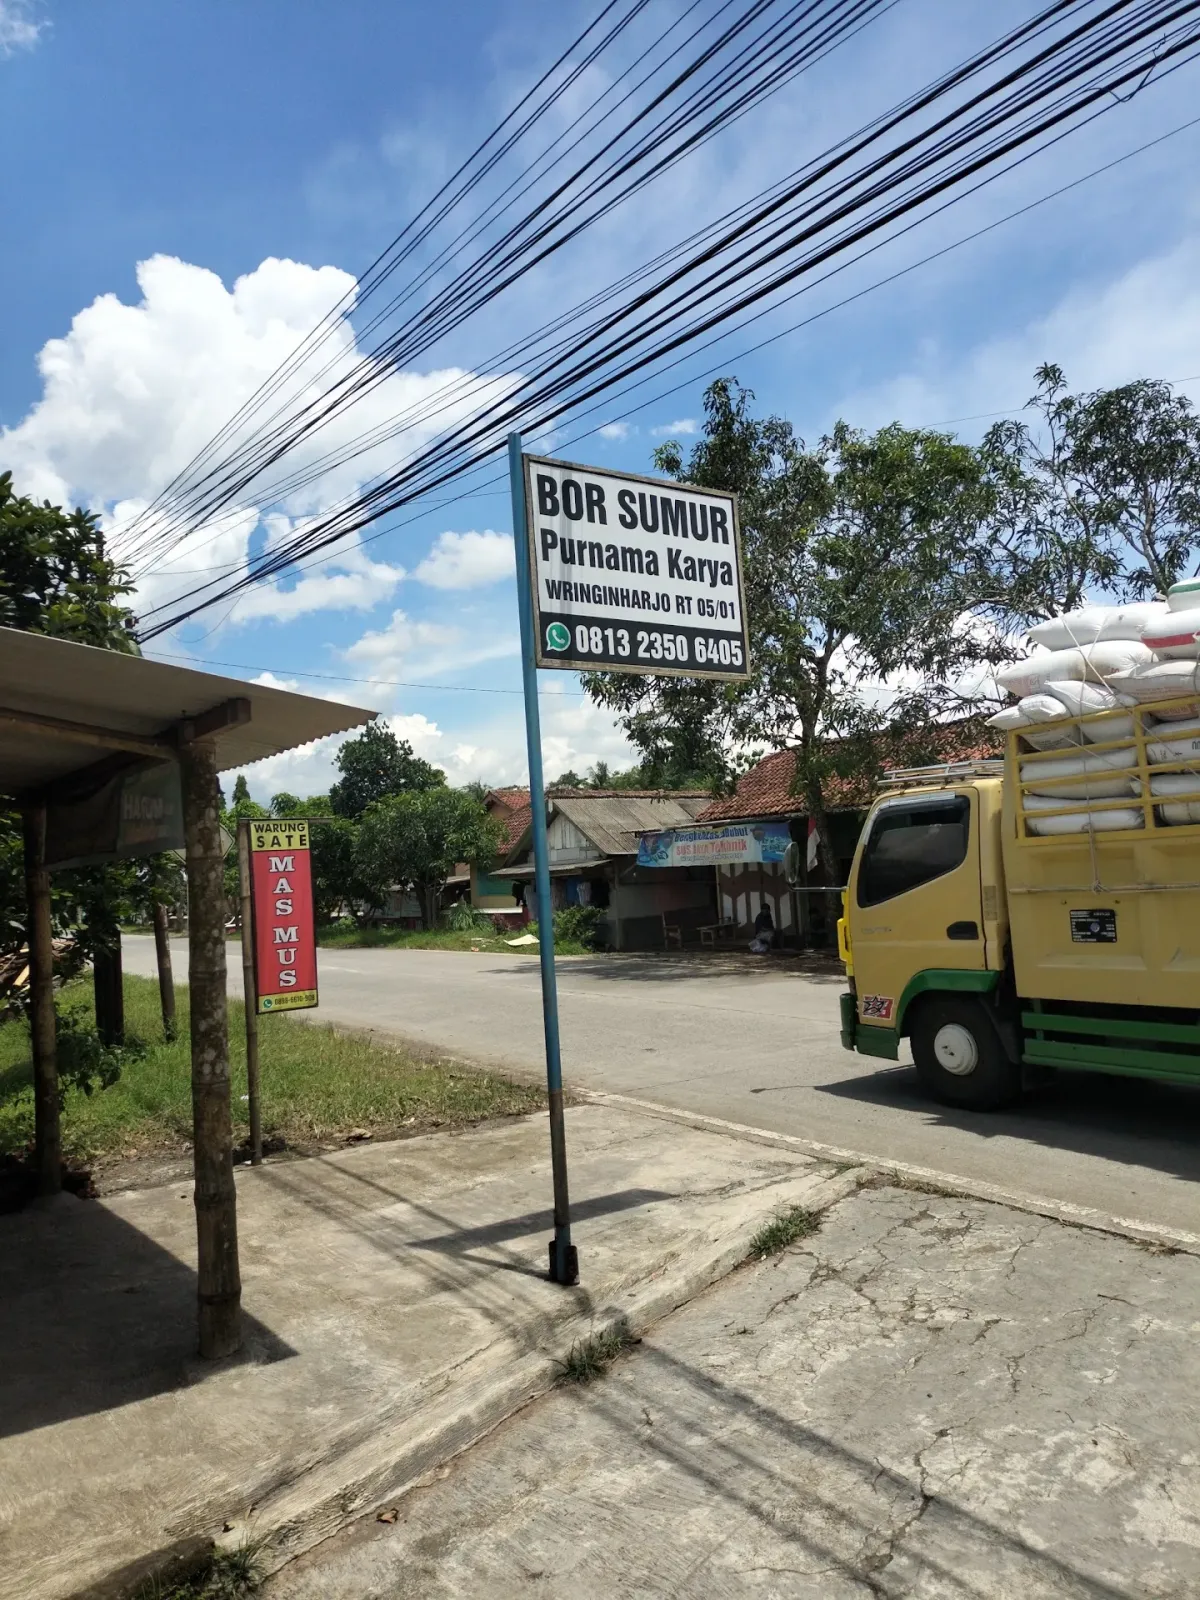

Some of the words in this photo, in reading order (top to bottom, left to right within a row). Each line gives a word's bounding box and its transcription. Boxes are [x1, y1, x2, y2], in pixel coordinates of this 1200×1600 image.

[536, 473, 608, 525] BOR
[617, 488, 729, 545] SUMUR
[540, 528, 659, 576] Purnama
[667, 547, 733, 588] Karya
[545, 578, 671, 613] WRINGINHARJO
[676, 594, 693, 615] RT
[697, 597, 735, 620] 05/01
[575, 624, 631, 657] 0813
[636, 630, 689, 662] 2350
[694, 636, 744, 667] 6405
[254, 823, 306, 833] WARUNG
[256, 834, 307, 848] SATE
[268, 855, 296, 916] MAS
[273, 926, 299, 987] MUS
